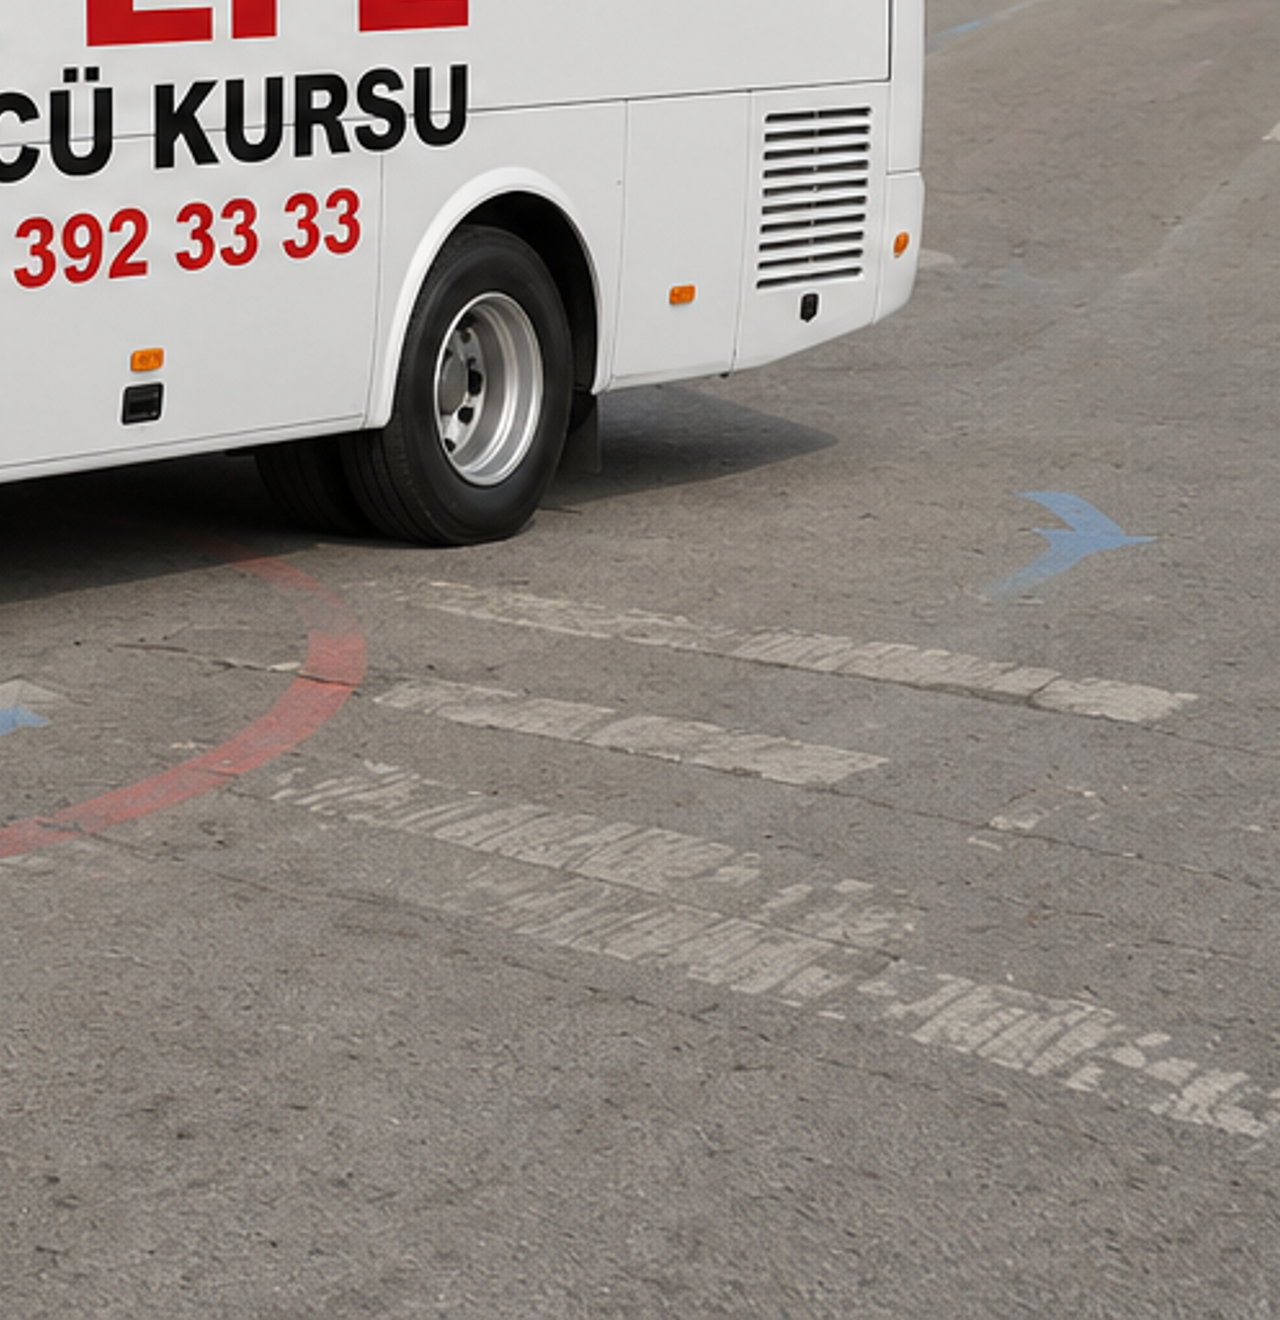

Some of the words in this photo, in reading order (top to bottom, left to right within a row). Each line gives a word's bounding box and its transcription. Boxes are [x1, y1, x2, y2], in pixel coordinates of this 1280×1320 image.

[152, 64, 469, 169] KURSU
[14, 207, 149, 289] 392
[175, 198, 260, 271] 33
[282, 188, 362, 259] 33
